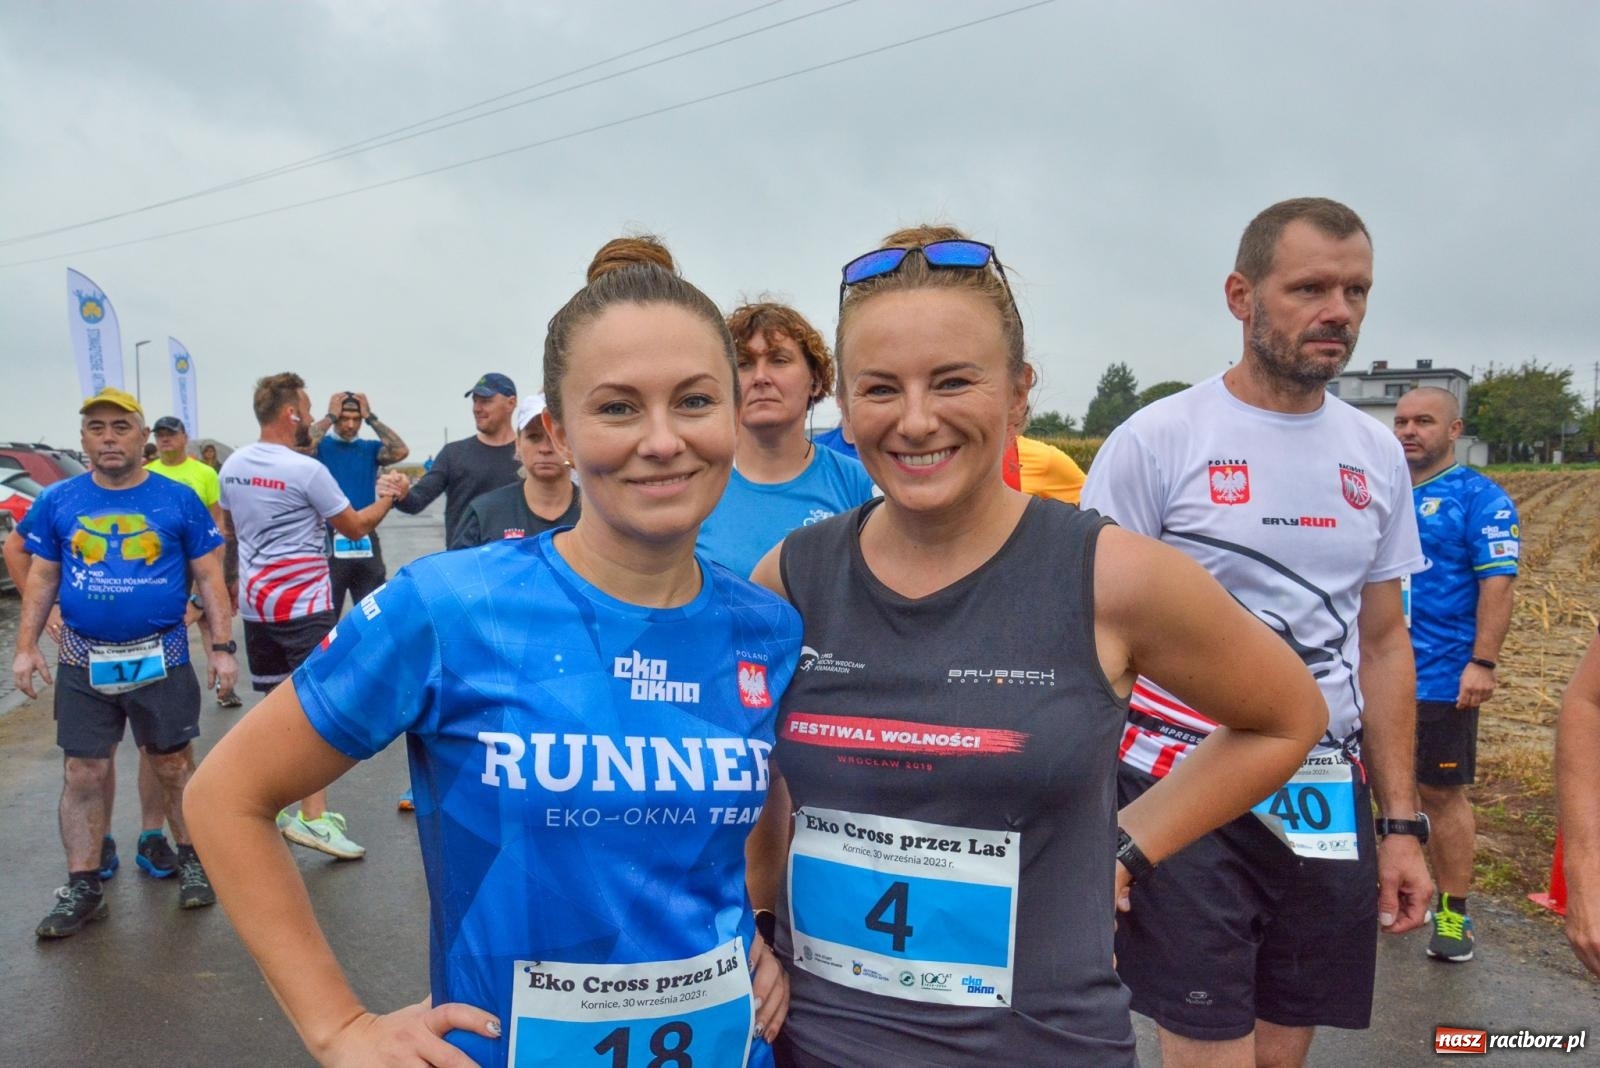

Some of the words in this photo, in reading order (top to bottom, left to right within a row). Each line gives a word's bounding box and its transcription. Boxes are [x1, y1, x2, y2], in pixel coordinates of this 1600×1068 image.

[614, 649, 667, 681] eko
[736, 649, 769, 661] POLAND
[112, 660, 143, 682] 17
[630, 679, 700, 704] okna
[789, 721, 875, 742] FESTIWAL
[881, 730, 980, 749] WOLNOŚCI
[1268, 786, 1332, 831] 40
[806, 814, 840, 834] Eko
[844, 823, 893, 846] Cross
[900, 835, 961, 853] przez
[968, 838, 1006, 858] Las
[872, 849, 883, 859] 30
[884, 852, 922, 865] września
[923, 856, 948, 867] 2023
[865, 880, 914, 952] 4
[528, 972, 576, 992] Eko
[583, 975, 650, 993] Cross
[656, 967, 713, 993] przez
[716, 955, 738, 978] Las
[580, 999, 620, 1010] Kornice,
[622, 998, 635, 1008] 30
[637, 994, 678, 1008] września
[679, 991, 702, 1003] 2023
[592, 1020, 693, 1068] 18
